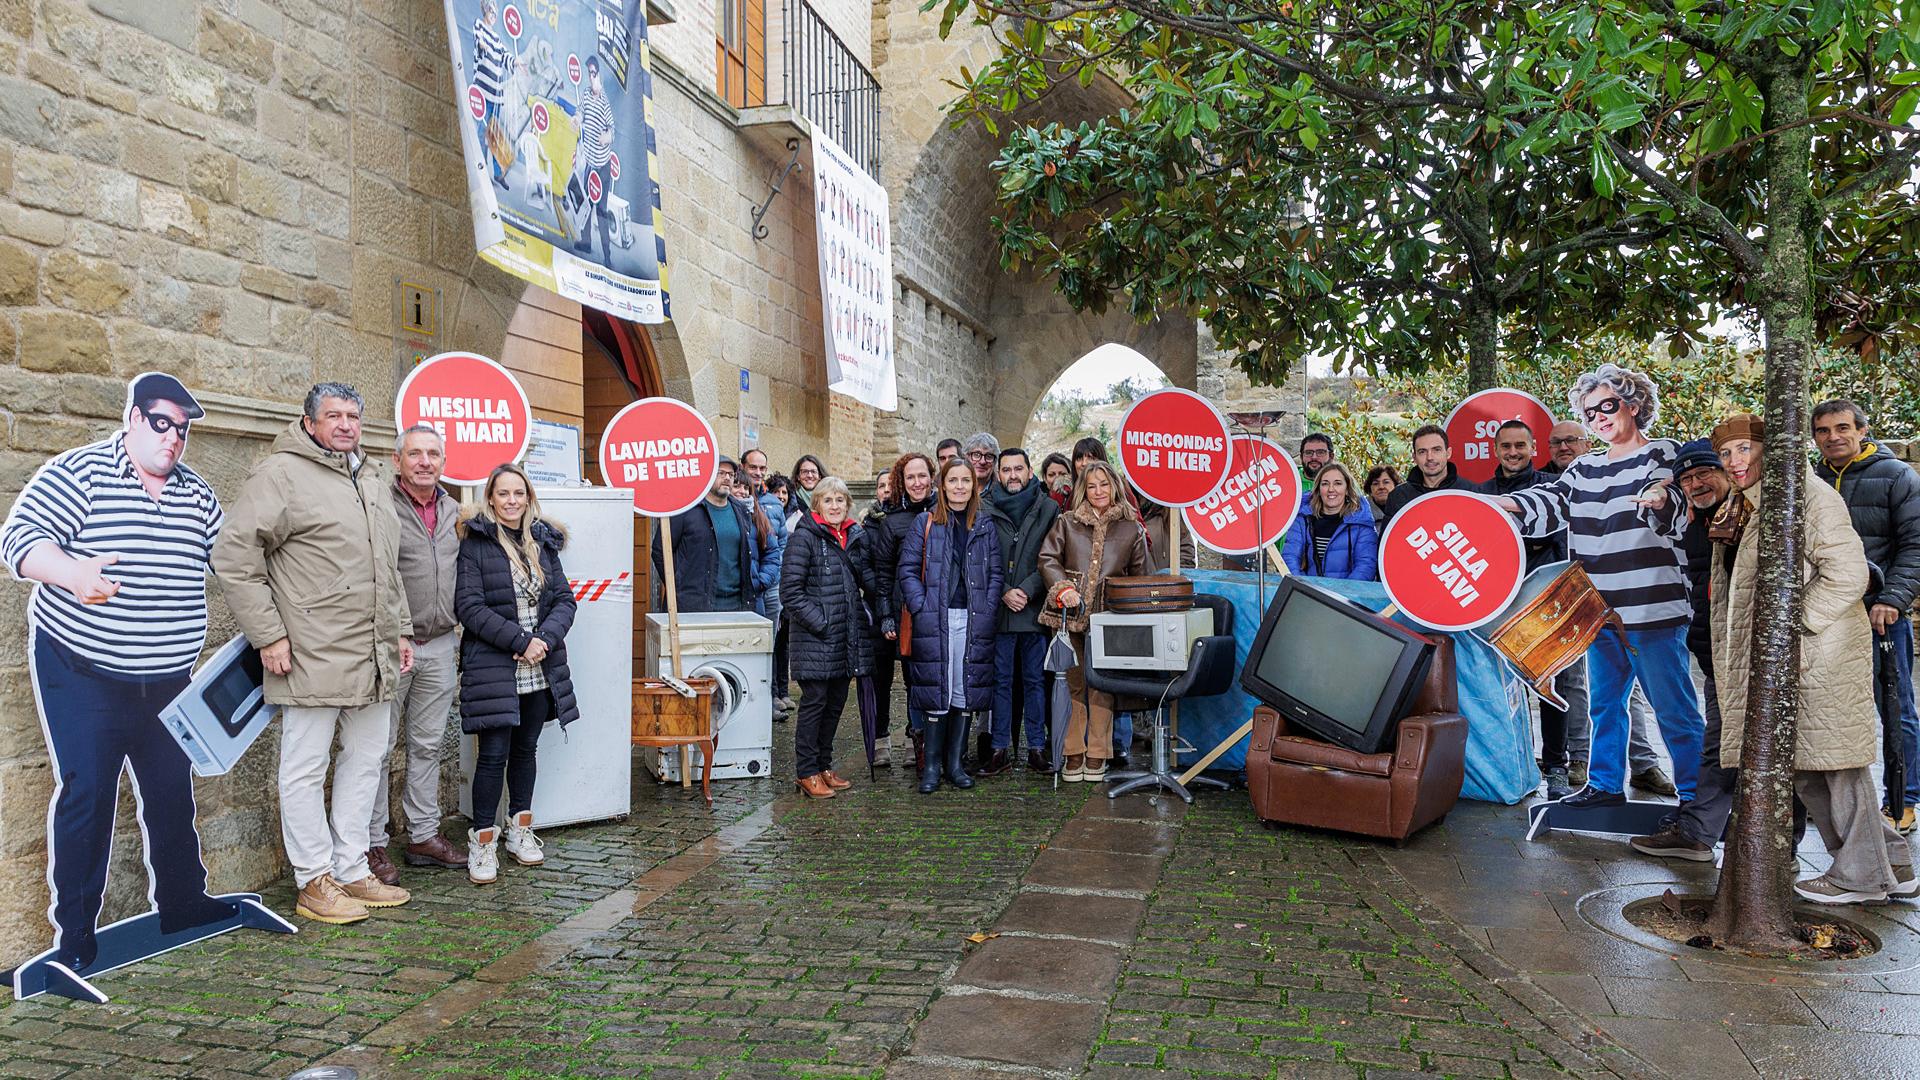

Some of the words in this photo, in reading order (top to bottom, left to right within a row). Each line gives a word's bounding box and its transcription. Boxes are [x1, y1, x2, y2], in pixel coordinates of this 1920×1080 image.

[418, 396, 512, 420] MESILLA
[456, 421, 513, 443] MARI
[1474, 415, 1522, 439] SO
[609, 436, 710, 461] LAVADORA
[1126, 430, 1223, 452] MICROONDAS
[1464, 442, 1490, 460] DE
[623, 462, 649, 482] DE
[654, 458, 700, 479] TERE
[1136, 448, 1160, 468] DE
[1167, 451, 1212, 472] IKER
[1193, 454, 1280, 516] COLCHÓN
[1209, 504, 1239, 532] DE
[1238, 477, 1282, 514] LUIS
[1435, 522, 1489, 581] SILLA
[1405, 526, 1439, 561] DE
[1430, 559, 1480, 608] JAVI
